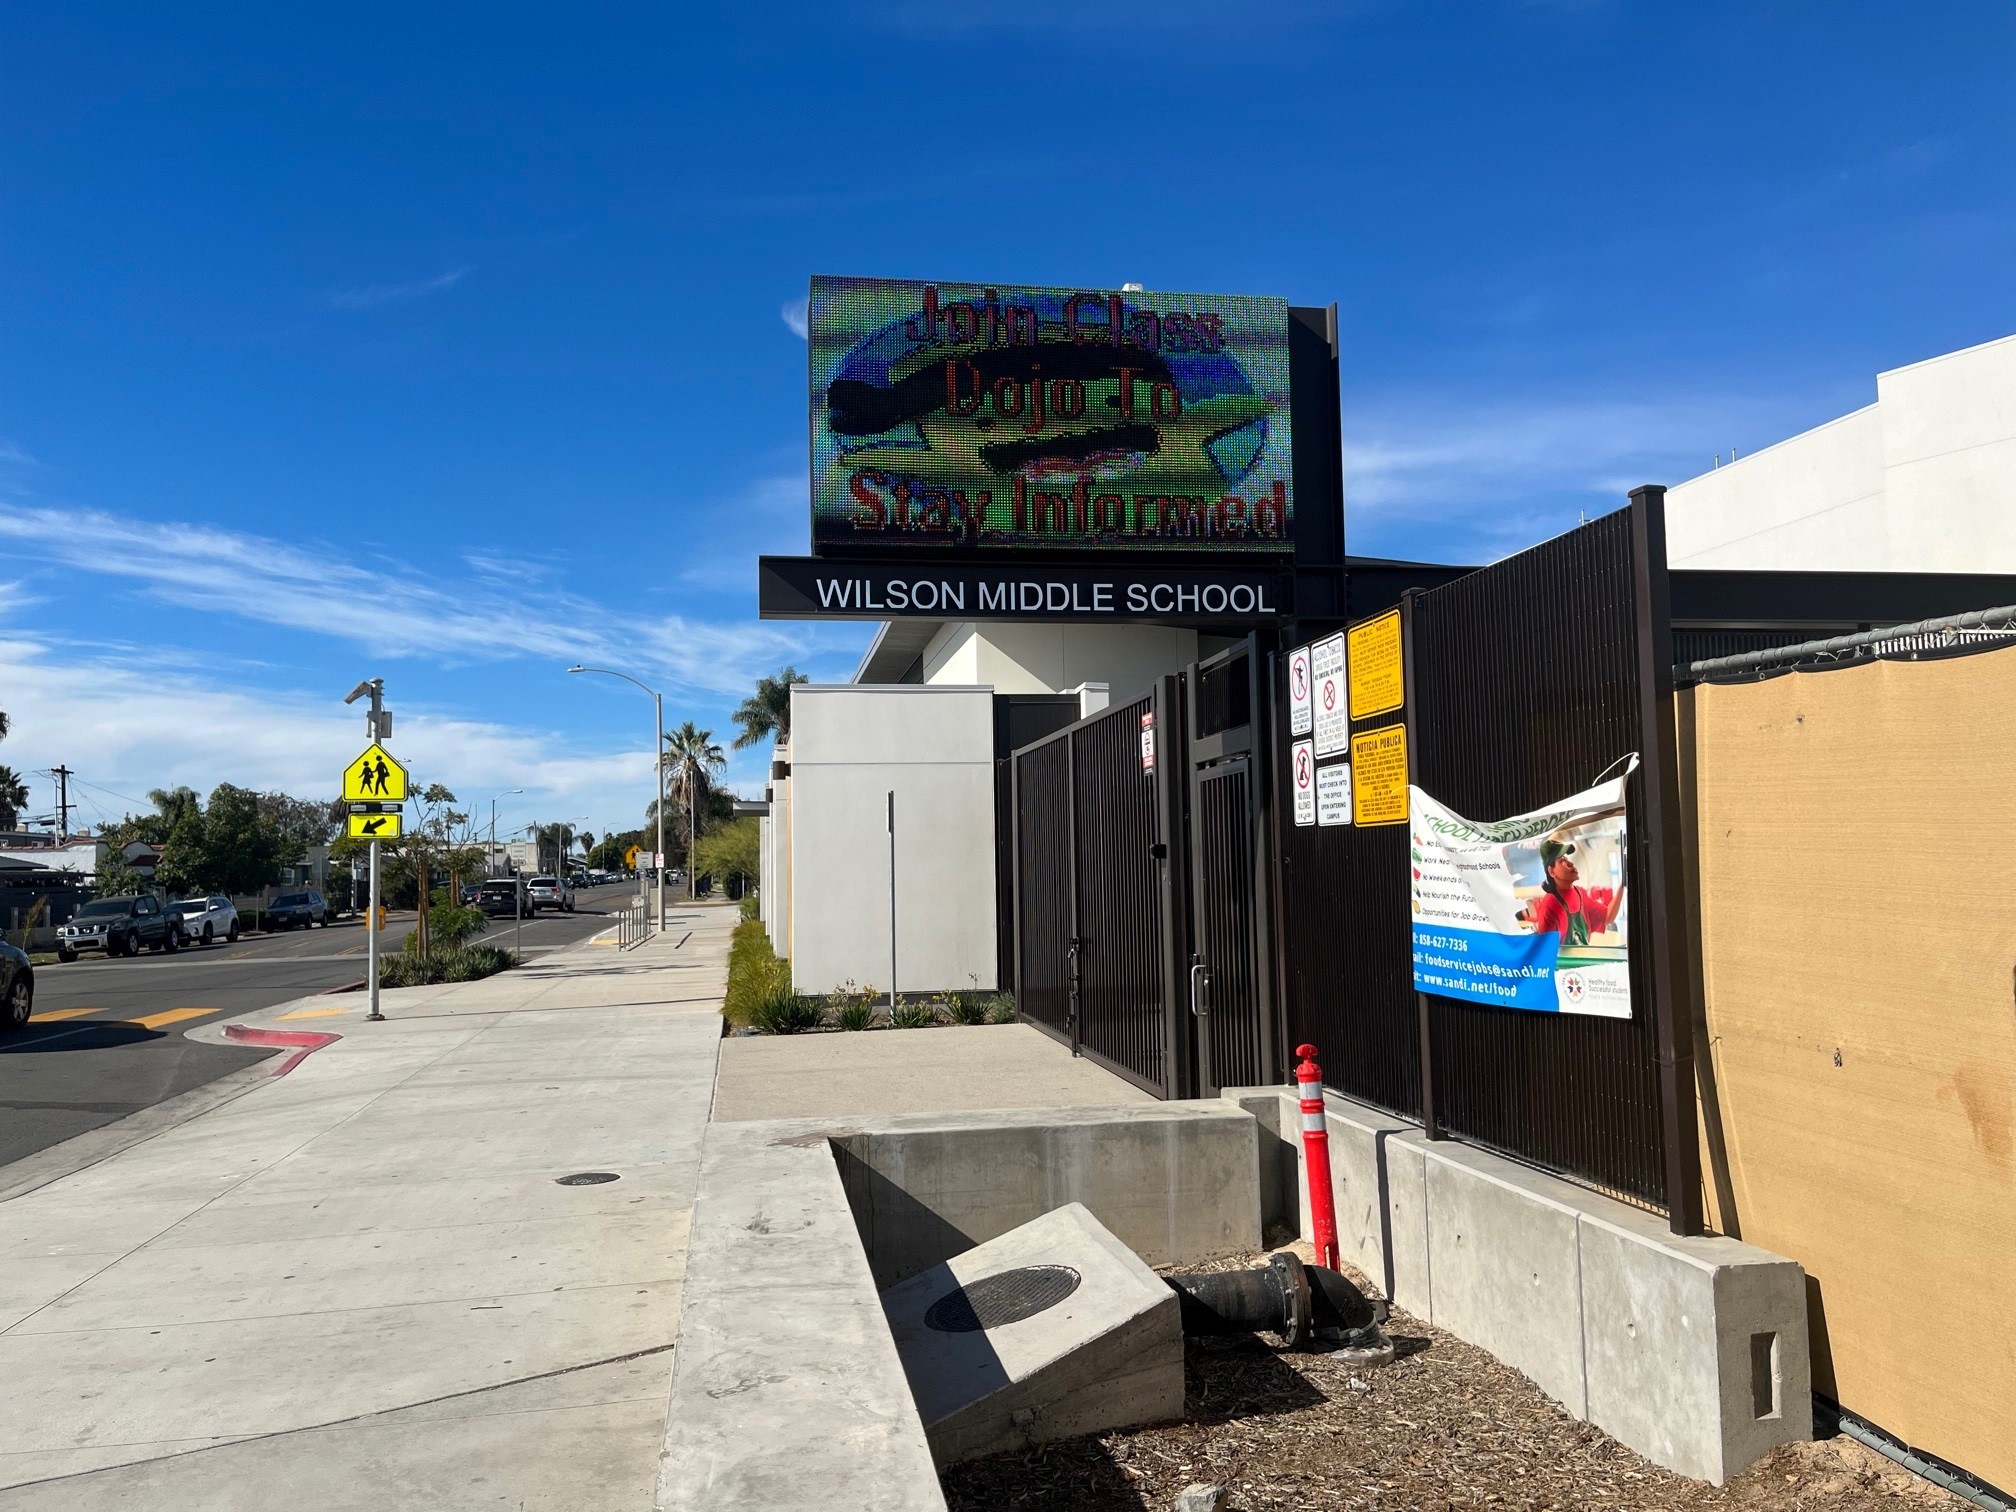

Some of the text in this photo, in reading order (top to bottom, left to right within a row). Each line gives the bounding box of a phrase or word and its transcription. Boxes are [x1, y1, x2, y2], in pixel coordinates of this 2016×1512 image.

[905, 285, 1226, 353] Join Class
[946, 358, 1184, 434] Dojo To
[849, 471, 1288, 544] Stay Informed
[816, 578, 1276, 613] WILSON MIDDLE SCHOOL
[1376, 621, 1390, 631] NOTICE
[1356, 734, 1401, 753] NOTICIA PUBLICA
[1330, 802, 1346, 810] ENTERING
[1326, 812, 1340, 820] CAMPUS
[1424, 814, 1471, 842] CHOOL
[1479, 862, 1500, 870] Schools
[1429, 874, 1457, 883] Weekends
[1431, 891, 1450, 900] Nourish
[1422, 908, 1450, 918] Opportunities
[1460, 912, 1470, 920] Job
[1420, 934, 1468, 952] 858-627-7336
[1425, 953, 1550, 978] foodservicejobs@sandi.net
[1424, 974, 1517, 997] www.sandi.net/food
